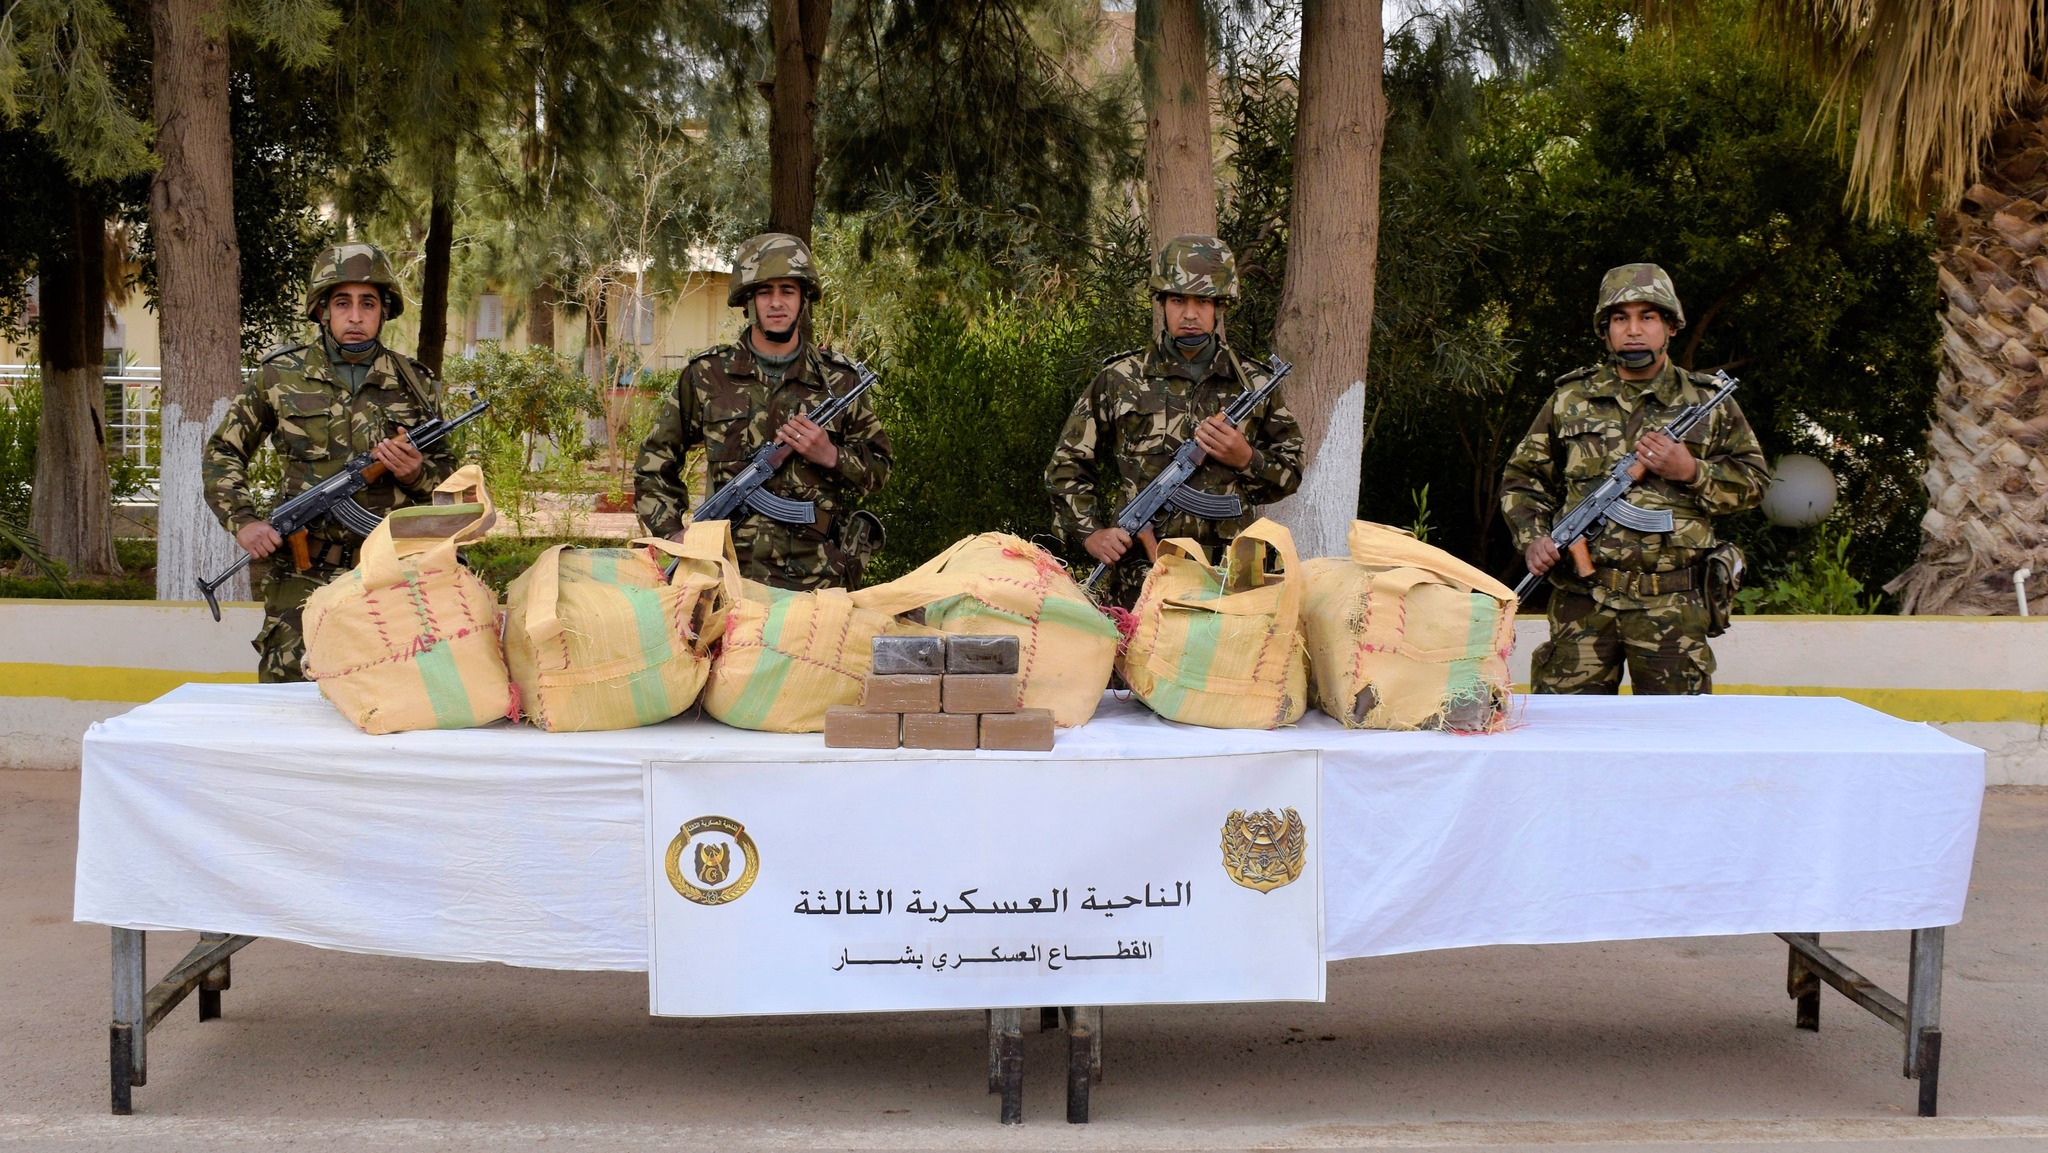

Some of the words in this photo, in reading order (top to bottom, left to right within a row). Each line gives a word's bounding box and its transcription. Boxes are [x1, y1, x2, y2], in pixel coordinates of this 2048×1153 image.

[793, 888, 893, 915] الثالثة
[905, 887, 1069, 924] العسكرية
[1080, 880, 1192, 918] الناحية
[832, 945, 924, 973] بشار
[931, 943, 1043, 973] العسكري
[1049, 940, 1153, 971] القطاع
